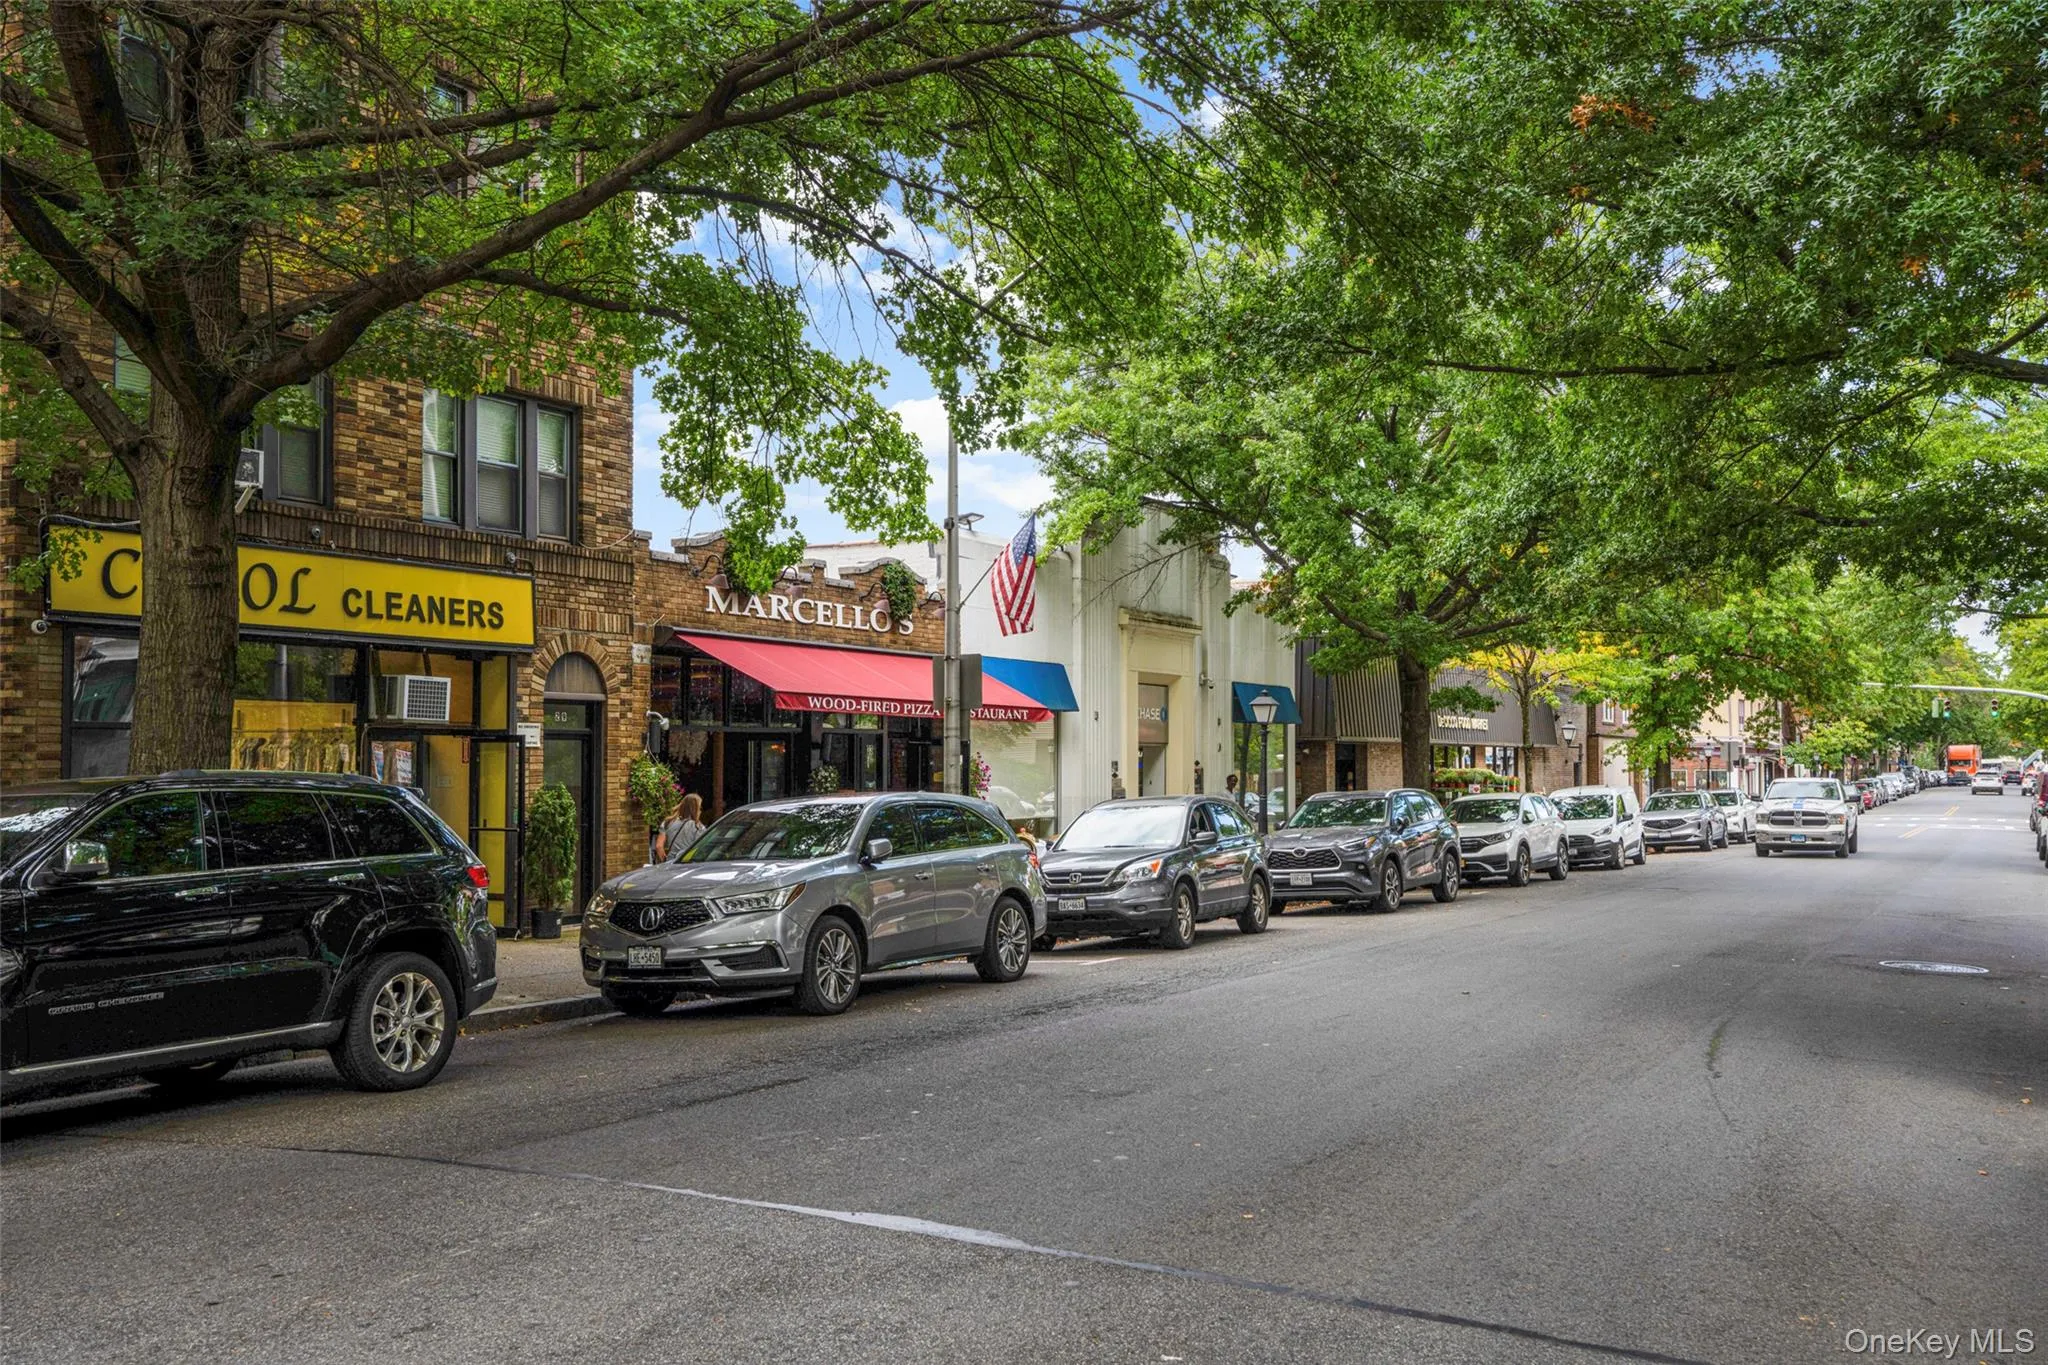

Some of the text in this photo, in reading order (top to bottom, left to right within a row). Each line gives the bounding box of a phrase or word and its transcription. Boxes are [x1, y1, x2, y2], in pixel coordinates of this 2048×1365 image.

[102, 548, 504, 629] COL CLEANERS
[705, 586, 914, 635] MARCELLOS
[807, 696, 901, 714] WOOD-FIRED
